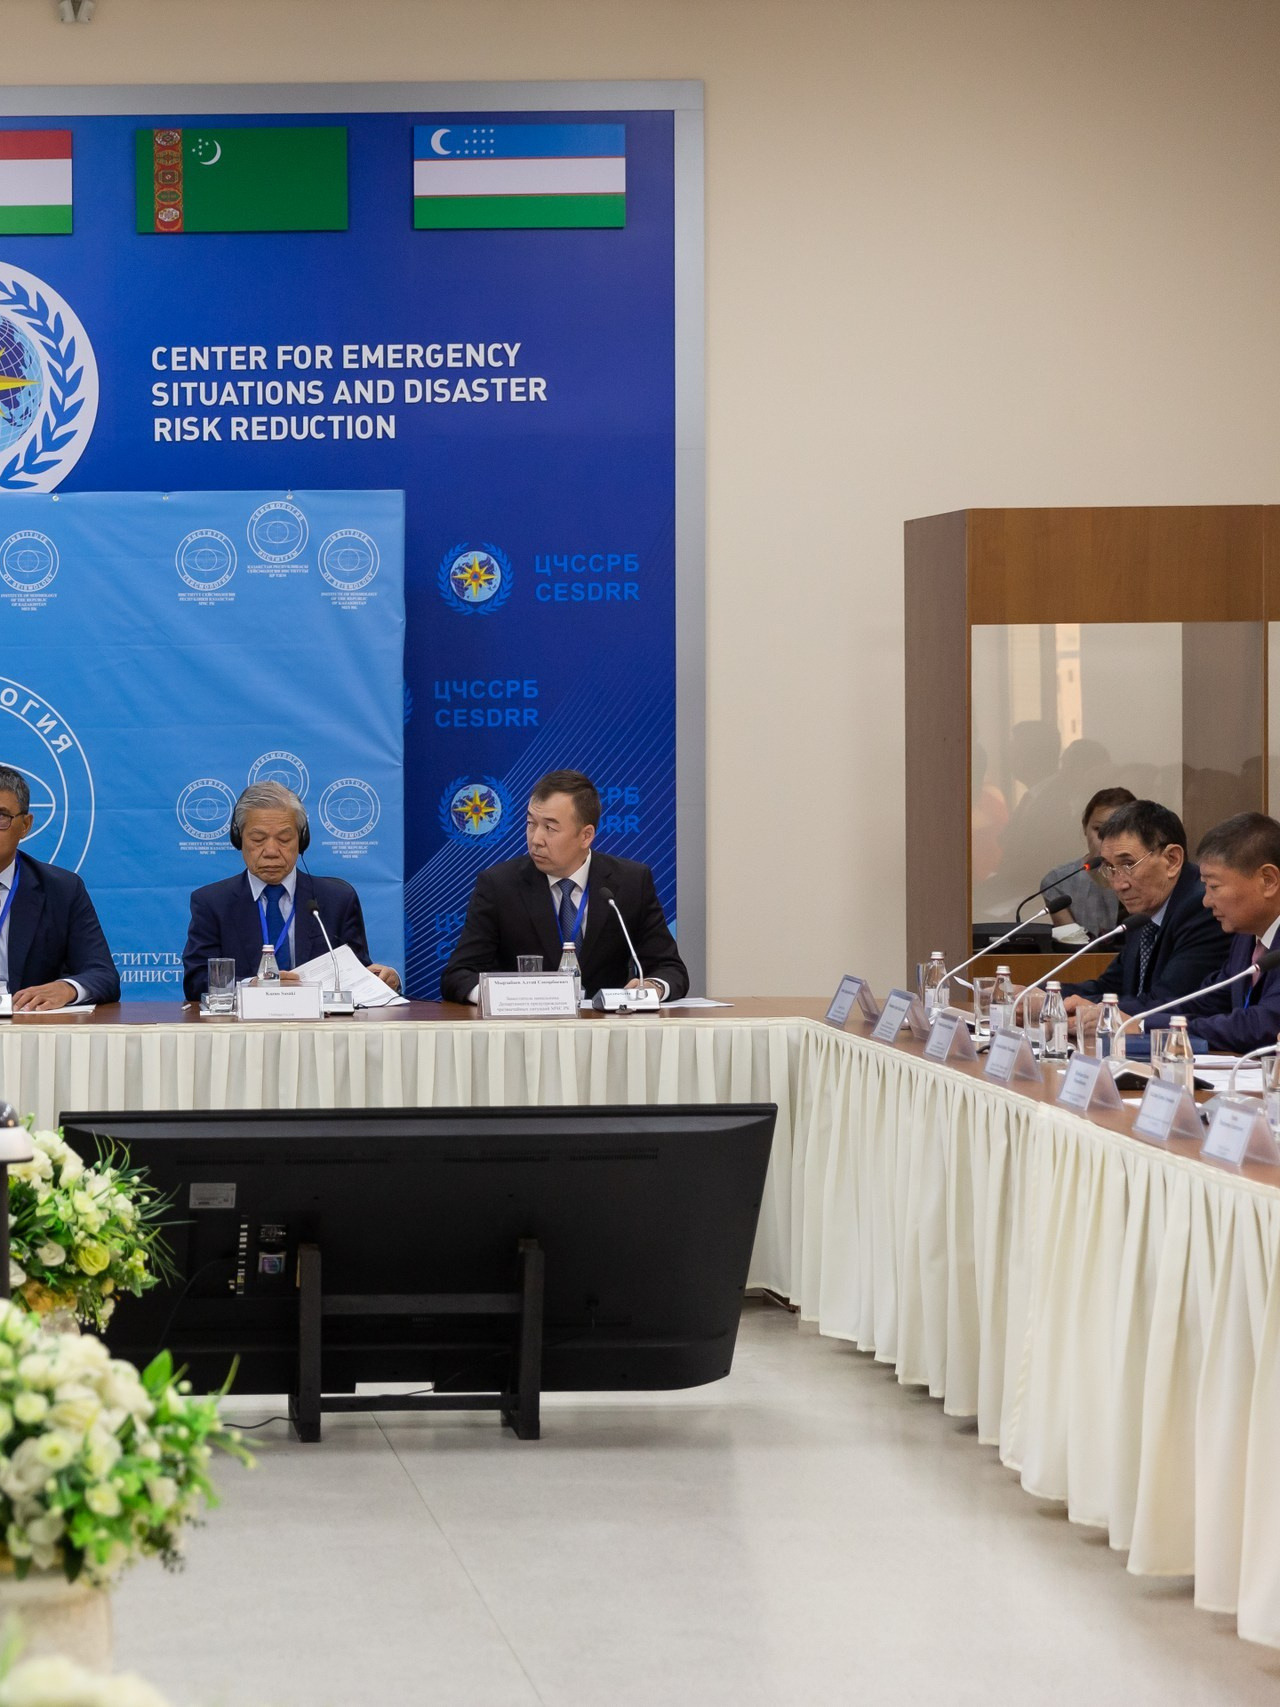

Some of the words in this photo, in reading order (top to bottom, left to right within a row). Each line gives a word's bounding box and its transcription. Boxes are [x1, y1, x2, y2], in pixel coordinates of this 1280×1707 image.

[151, 346, 267, 371] CENTER
[277, 345, 333, 369] FOR
[343, 343, 521, 369] EMERGENCY
[151, 381, 324, 407] SITUATIONS
[332, 379, 395, 404] AND
[404, 377, 547, 403] DISASTER
[154, 417, 222, 442] RISK
[230, 415, 396, 441] REDUCTION
[535, 553, 640, 576] ЦЧССРБ
[535, 582, 640, 601] CESDRR
[434, 679, 539, 702] ЦЧССРБ
[435, 708, 539, 728] CESDRR
